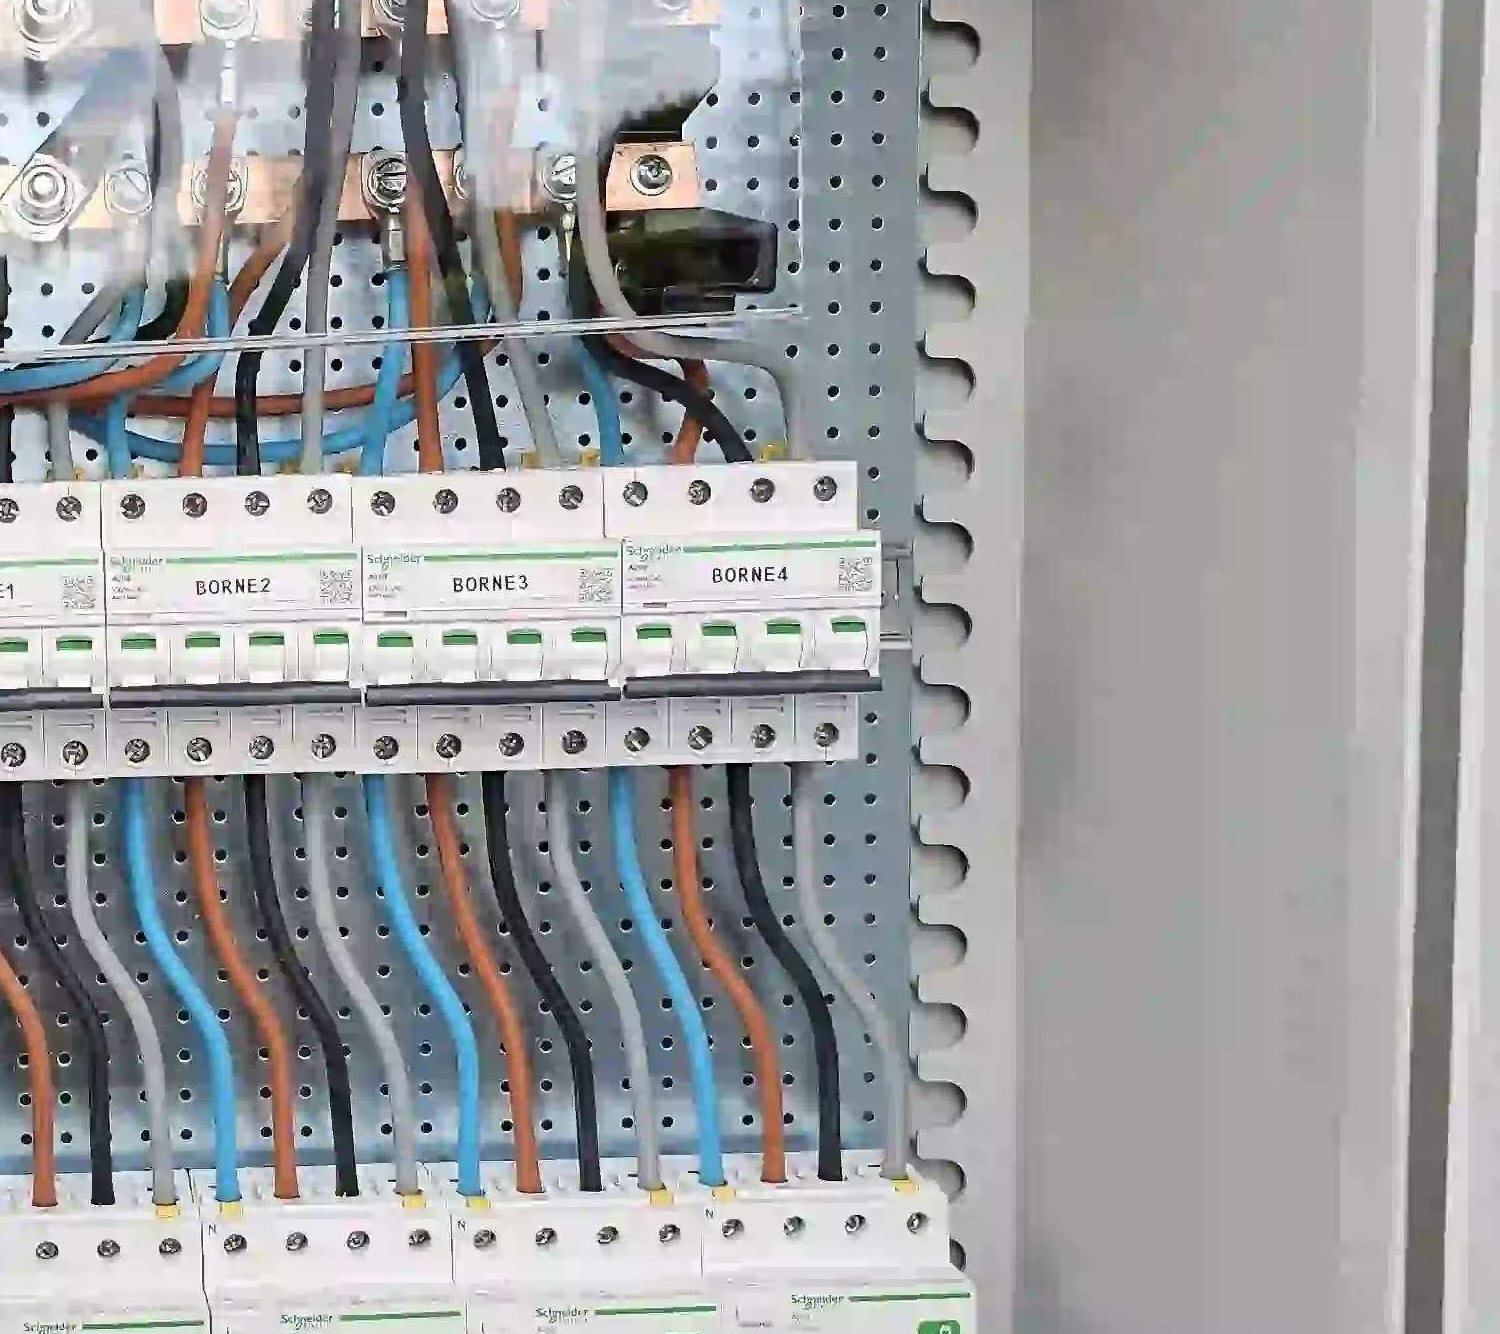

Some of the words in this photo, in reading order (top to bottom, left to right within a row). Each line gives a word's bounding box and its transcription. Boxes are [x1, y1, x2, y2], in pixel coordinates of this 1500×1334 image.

[452, 574, 529, 593] BORNE3
[711, 566, 789, 584] BORNE4
[195, 577, 271, 596] BORNE2
